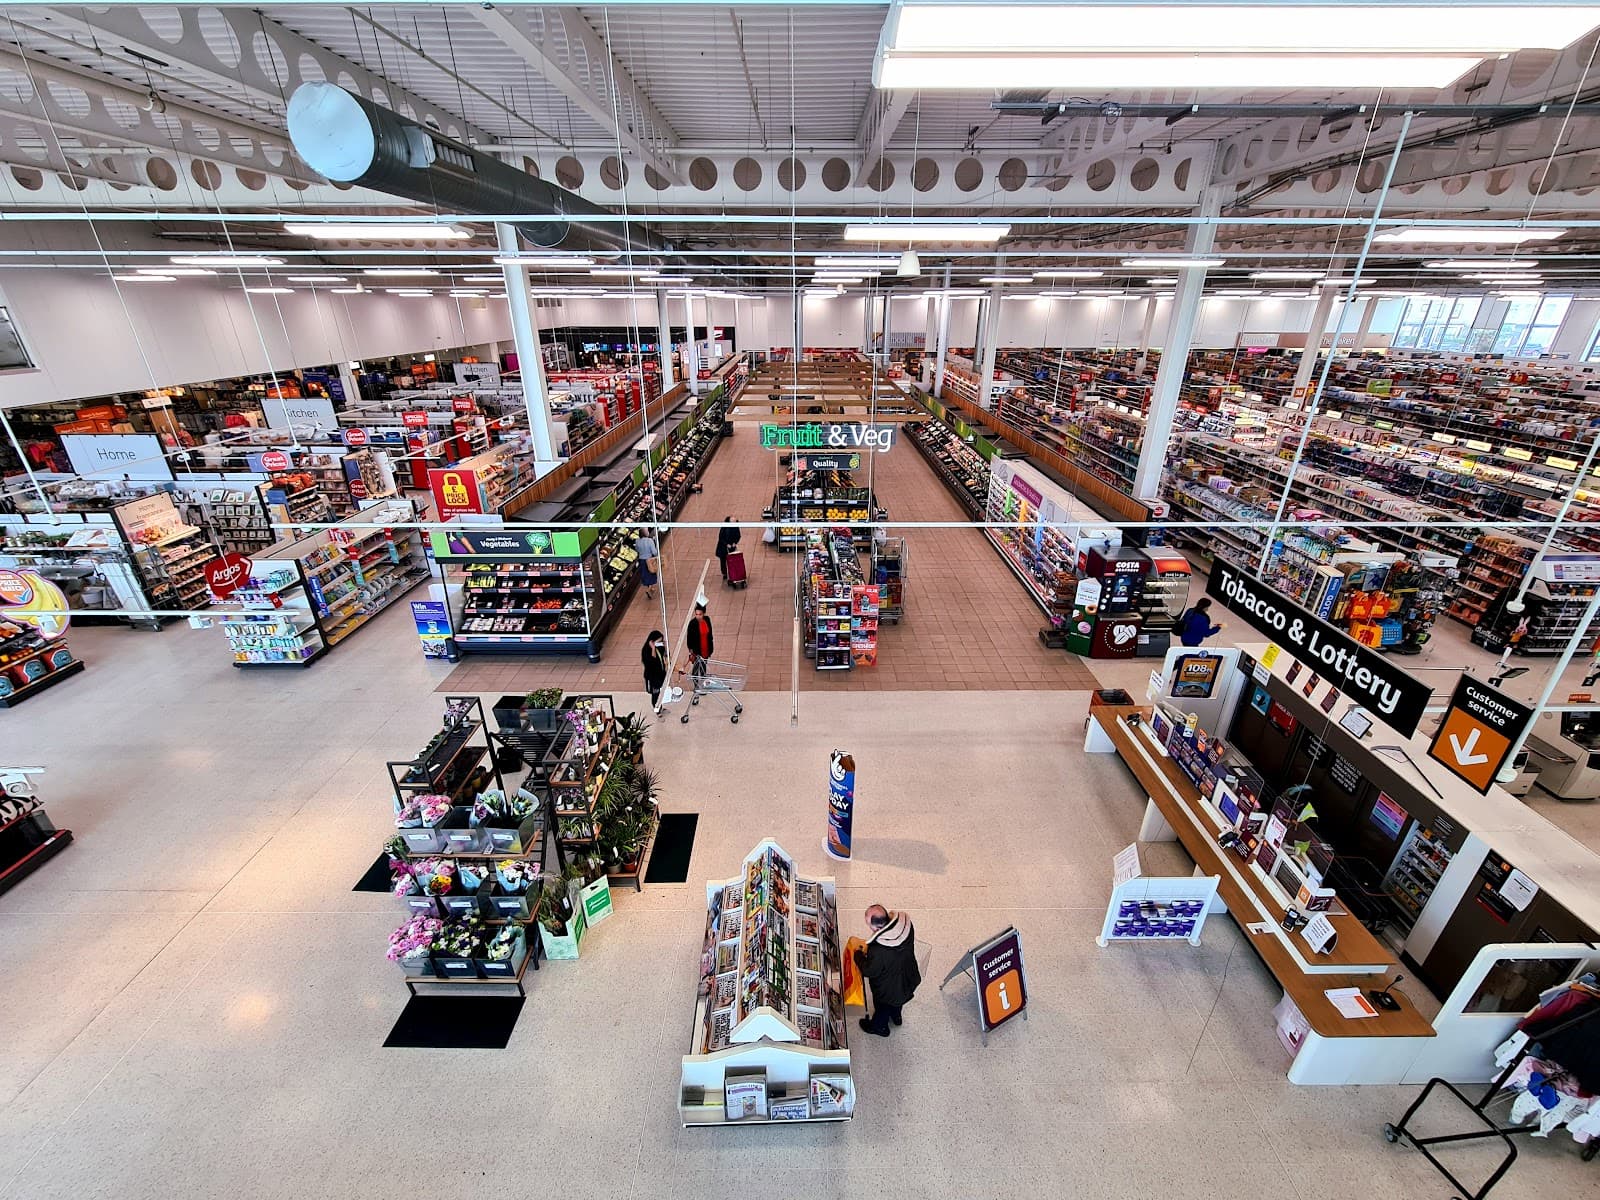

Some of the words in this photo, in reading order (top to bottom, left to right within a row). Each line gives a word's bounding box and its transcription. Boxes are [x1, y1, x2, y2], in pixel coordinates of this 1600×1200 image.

[283, 408, 319, 418] Kitchen
[762, 424, 823, 448] Fruit
[828, 424, 848, 447] &
[850, 424, 893, 452] Veg
[97, 447, 137, 461] Home
[812, 460, 839, 469] Quality
[480, 540, 520, 548] Vegetables
[213, 564, 241, 582] Argos
[1220, 570, 1286, 630] Tobacco
[1288, 618, 1307, 646] &
[1308, 630, 1402, 715] Lottery
[1466, 686, 1519, 720] Customer
[1467, 700, 1506, 726] service
[983, 948, 1014, 971] Customer
[988, 960, 1012, 978] service
